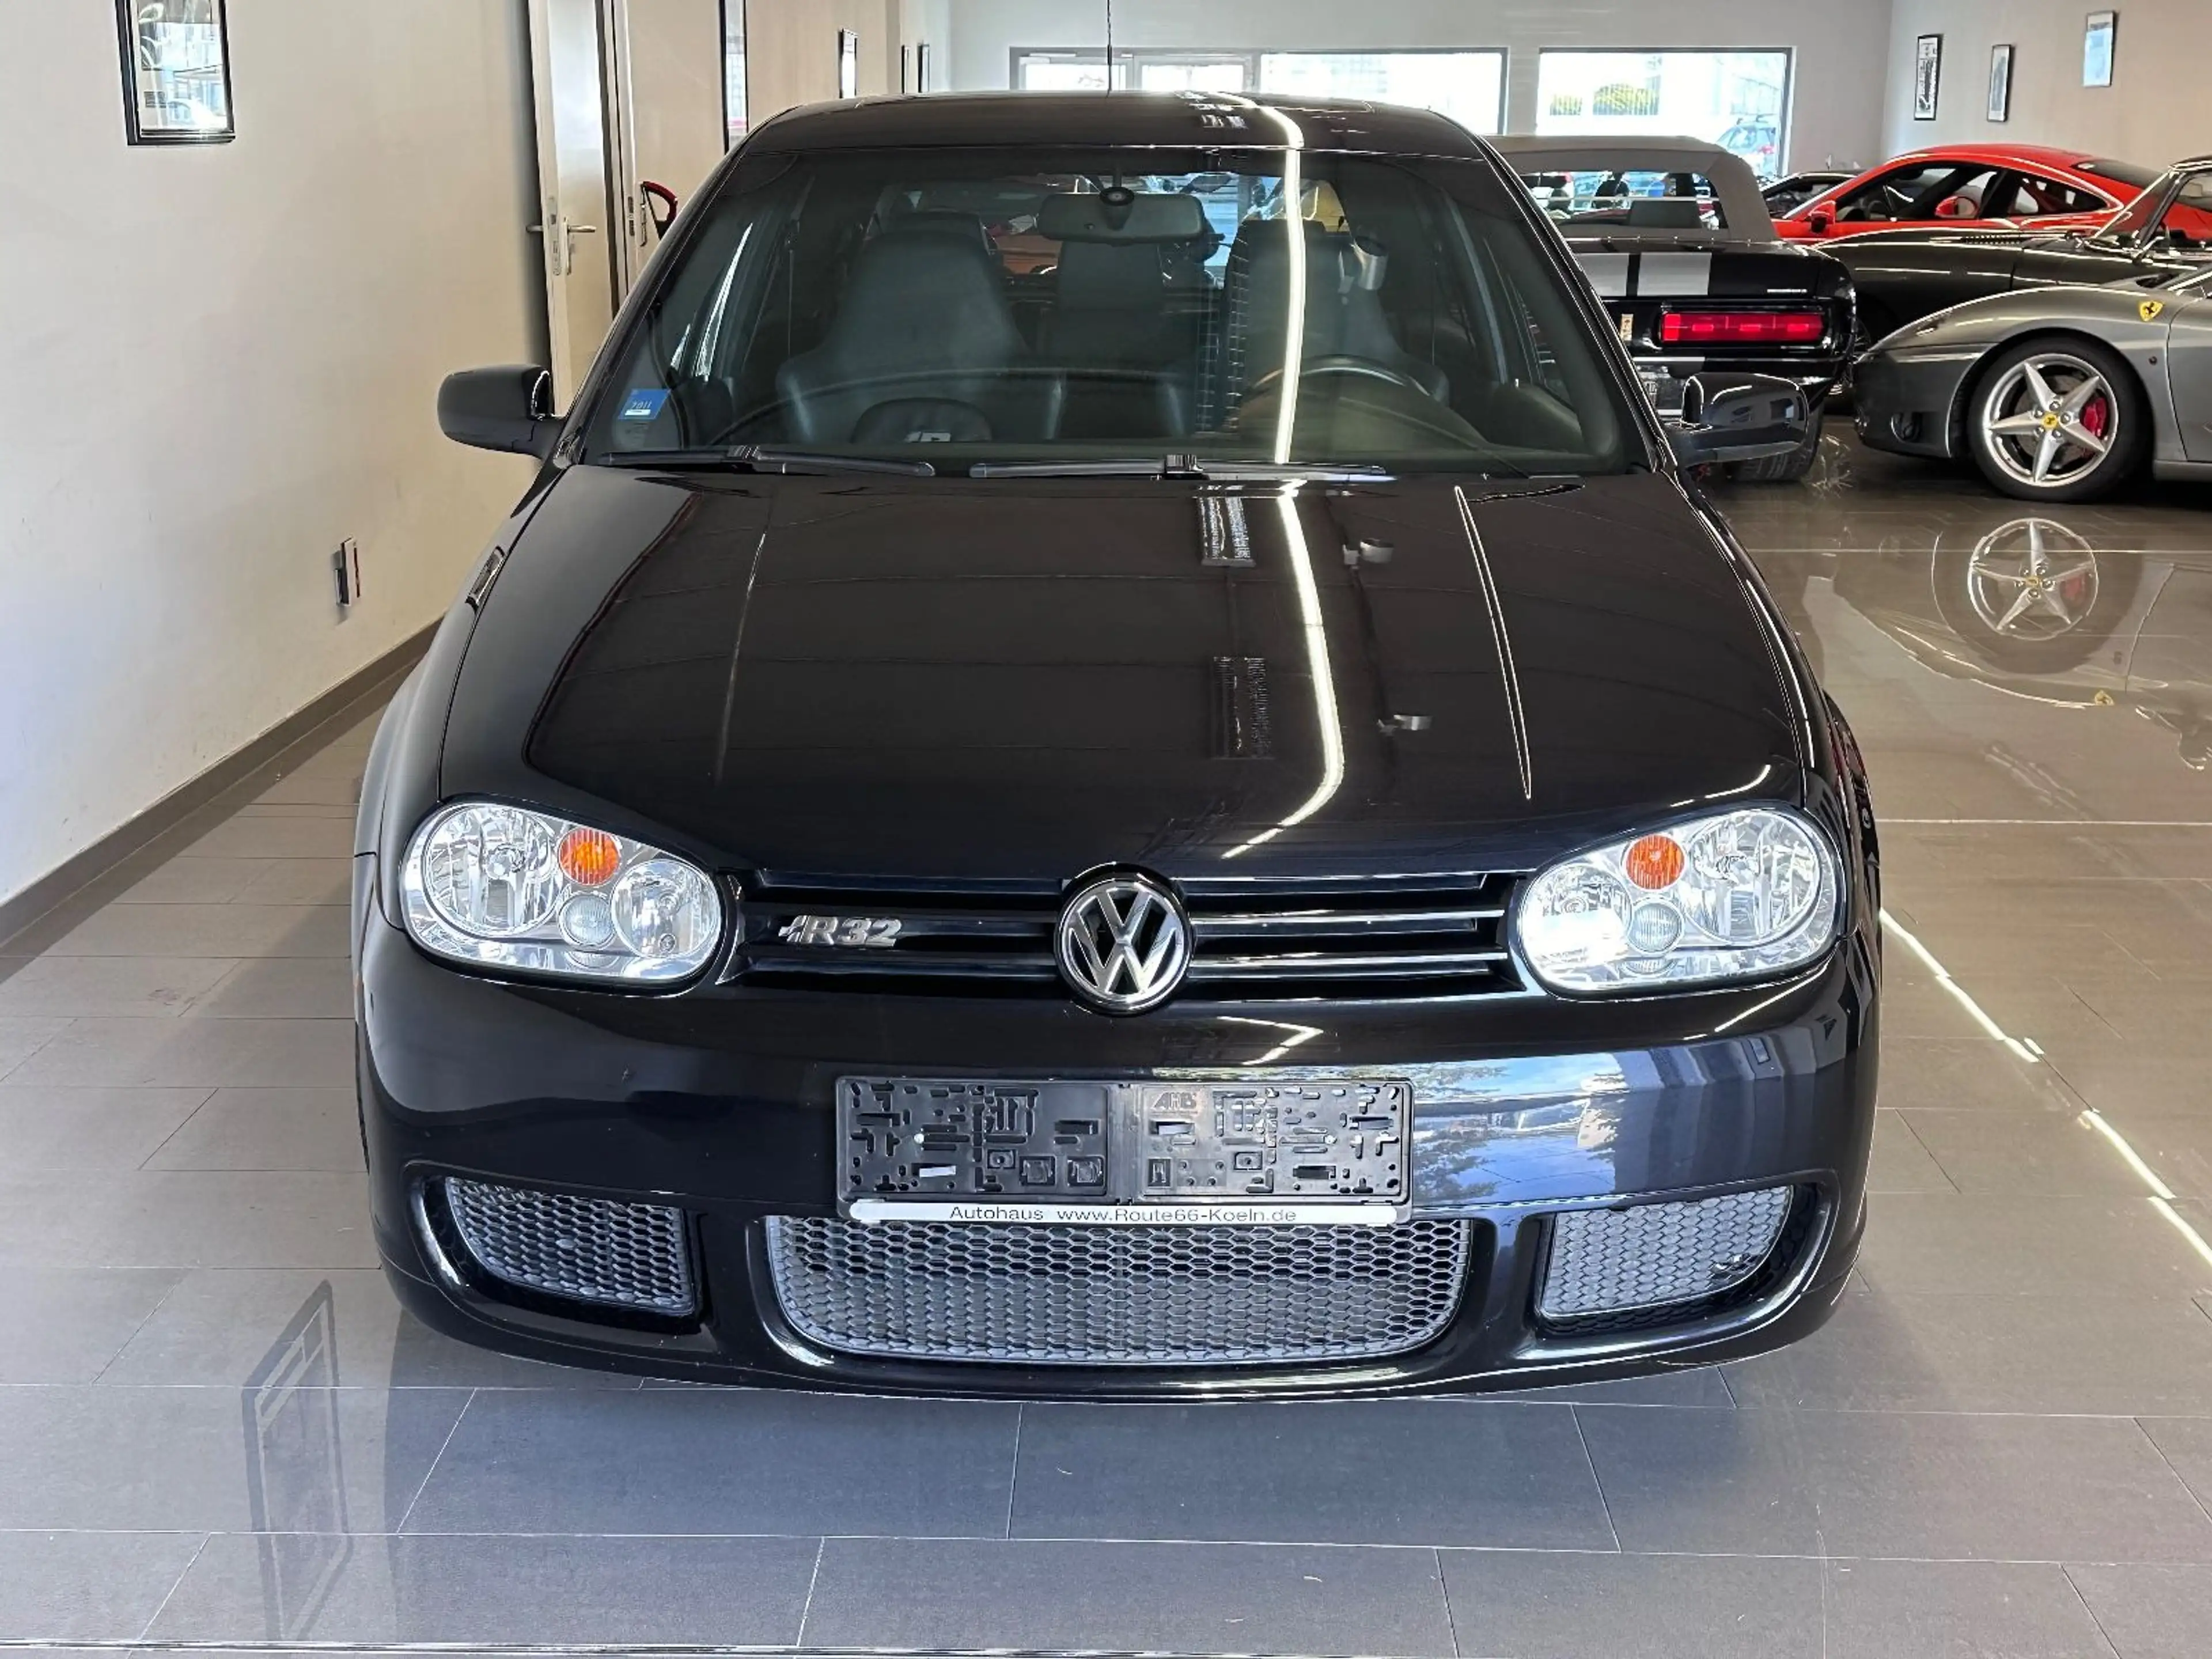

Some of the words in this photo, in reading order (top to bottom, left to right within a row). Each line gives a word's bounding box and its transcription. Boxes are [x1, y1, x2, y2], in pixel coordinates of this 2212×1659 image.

[799, 915, 902, 947] R32
[1062, 878, 1187, 1008] VW
[950, 1206, 1044, 1221] Autohaus
[1056, 1208, 1297, 1222] www.Route66-Koeln.de
